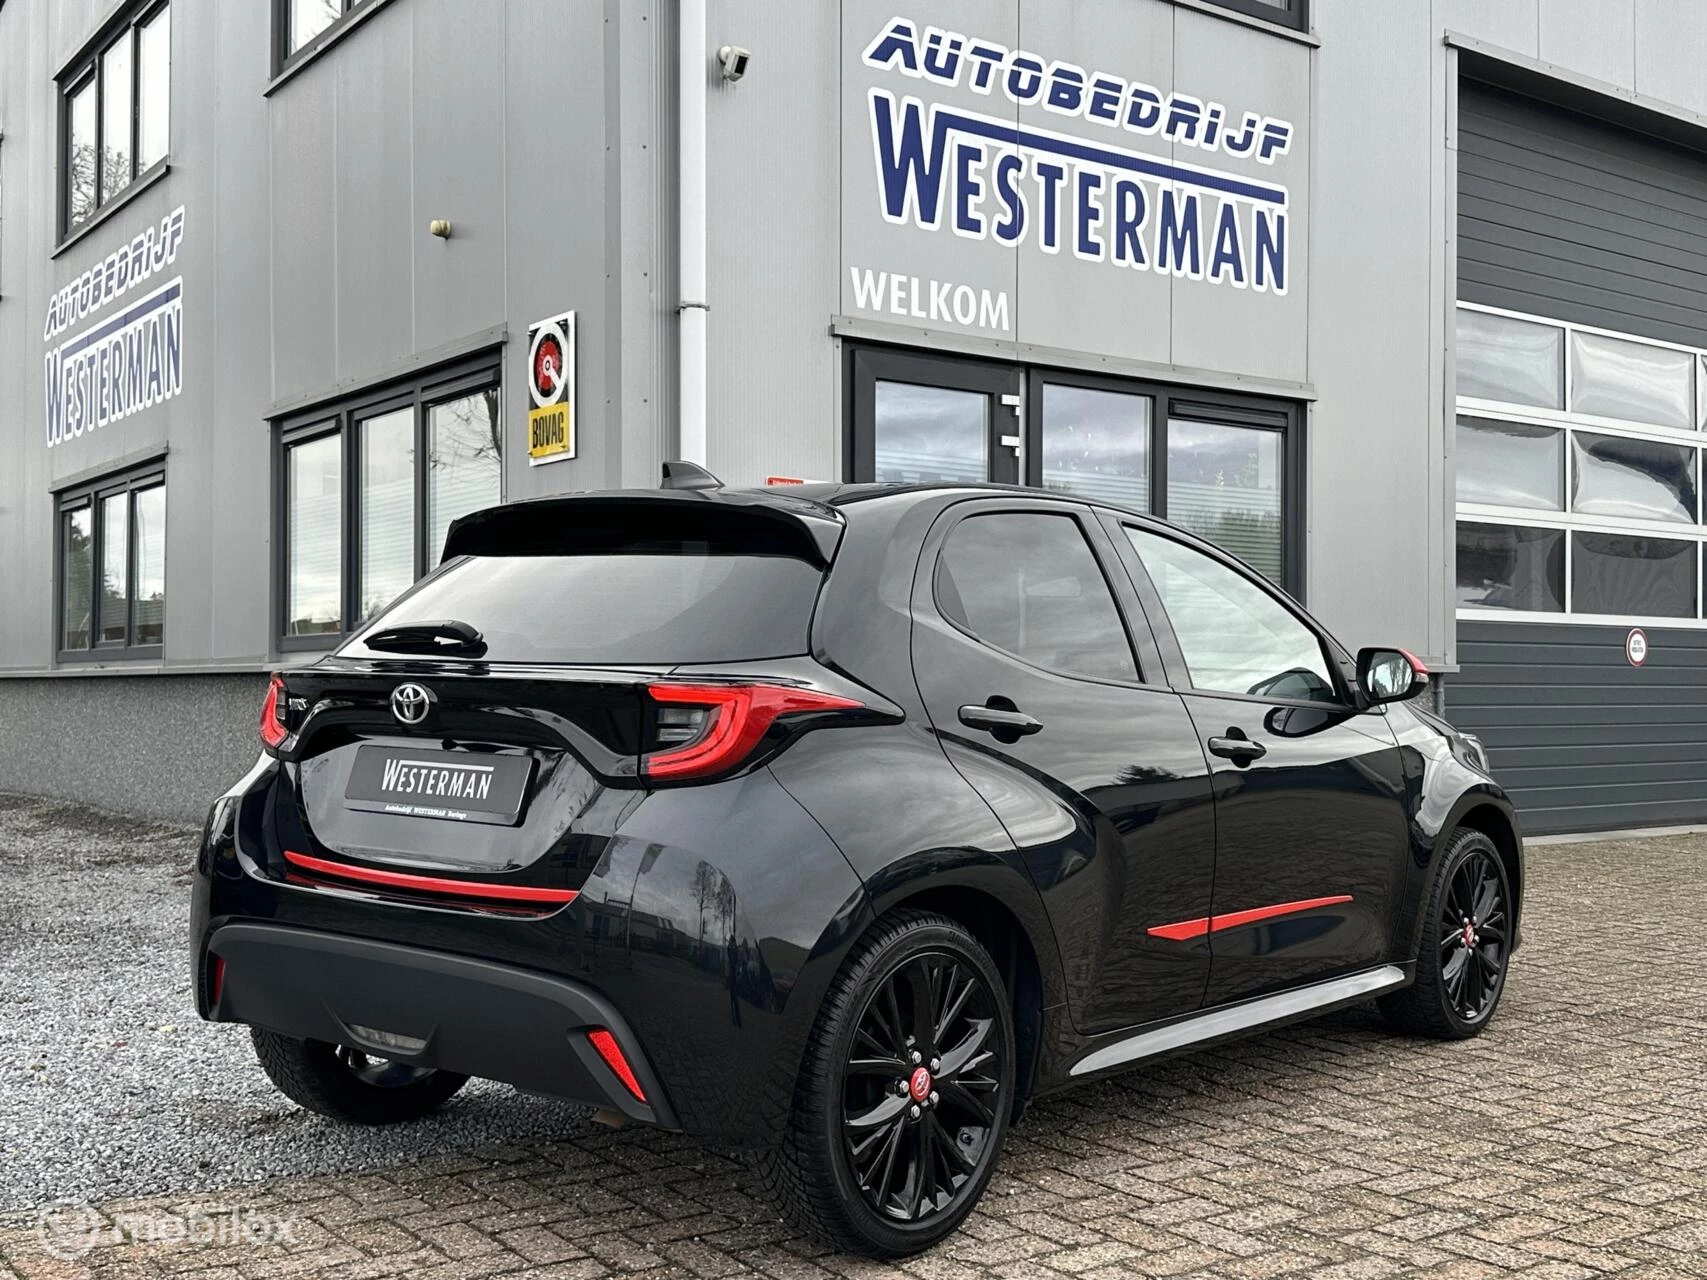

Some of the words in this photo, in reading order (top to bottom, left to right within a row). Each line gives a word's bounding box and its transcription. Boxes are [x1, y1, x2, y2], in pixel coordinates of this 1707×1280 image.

[865, 20, 1291, 161] AUTOBEDRIJF
[870, 91, 1288, 292] WESTERMAN
[45, 208, 184, 339] AUTOBEDRIJF
[850, 266, 1009, 331] WELKOM
[46, 286, 182, 445] WESTERMAN
[532, 411, 565, 449] BOVAG
[381, 758, 495, 800] WESTERMAN
